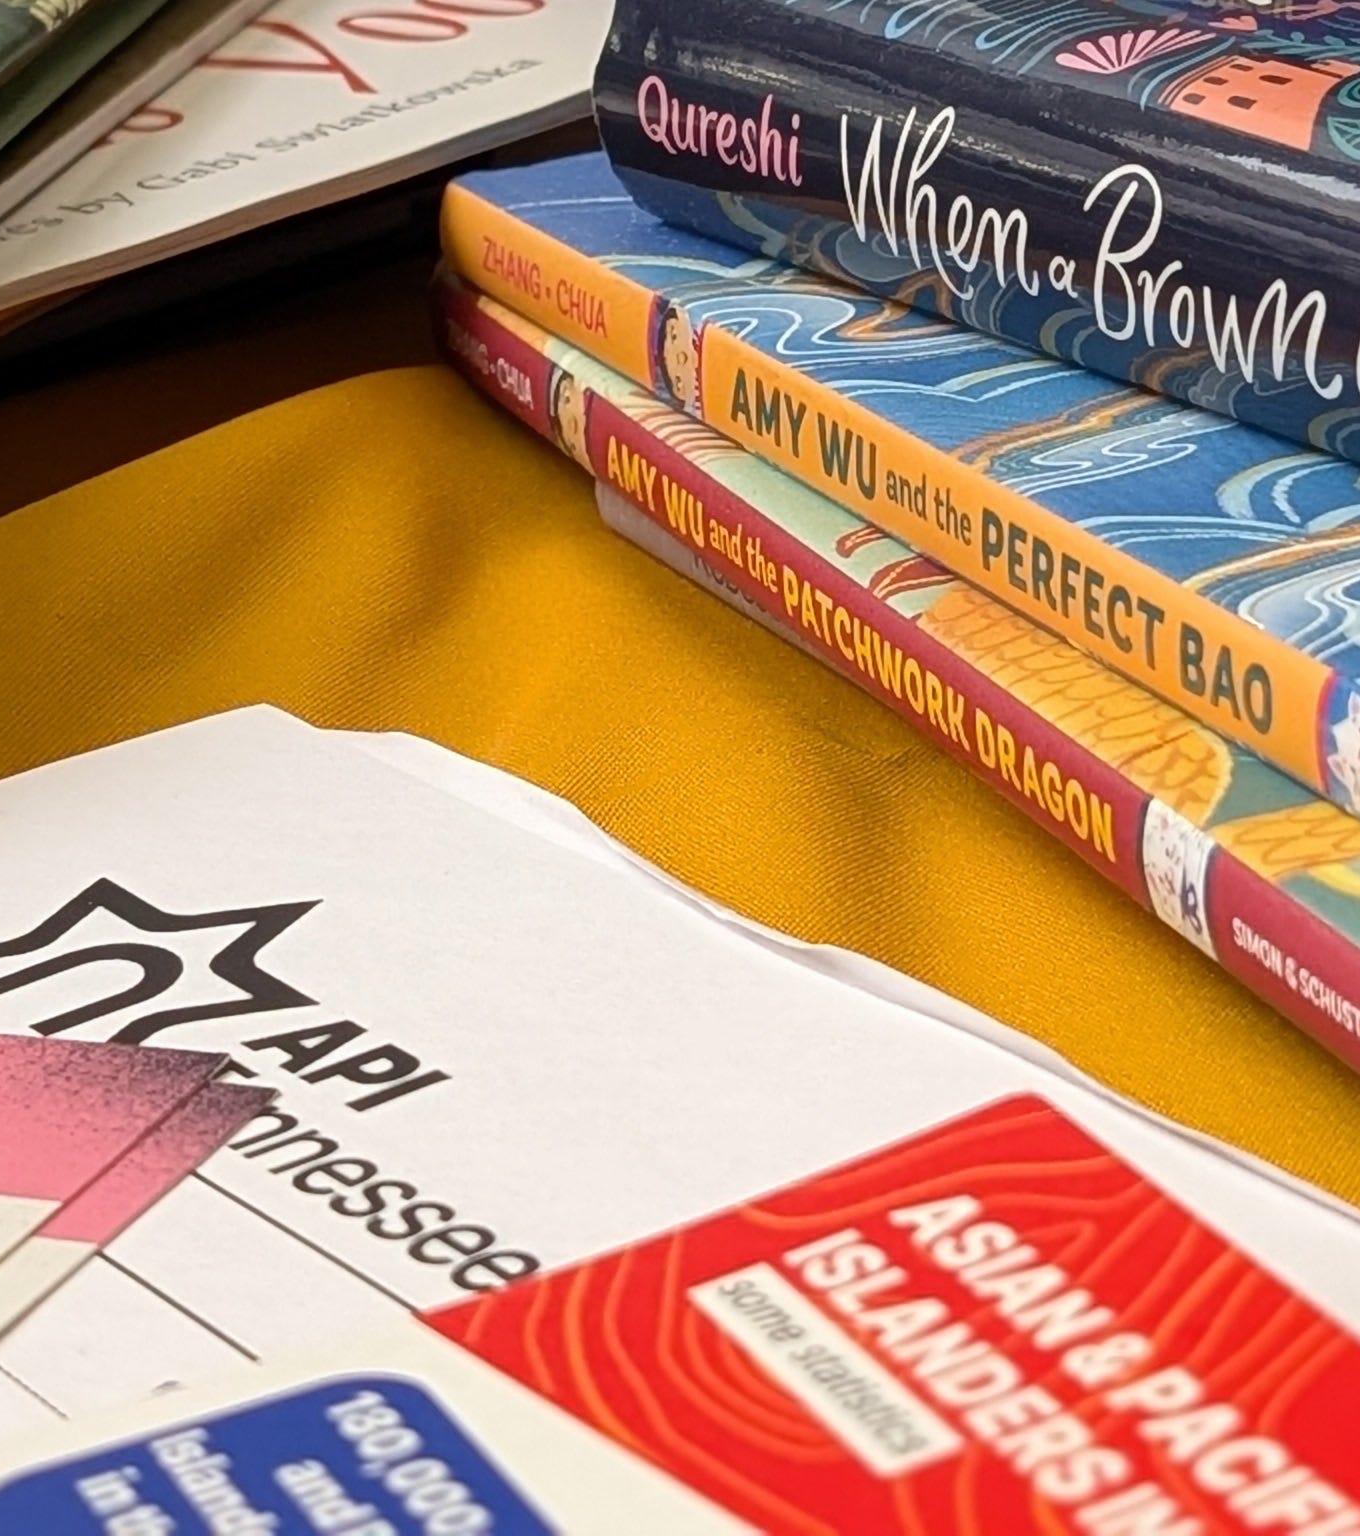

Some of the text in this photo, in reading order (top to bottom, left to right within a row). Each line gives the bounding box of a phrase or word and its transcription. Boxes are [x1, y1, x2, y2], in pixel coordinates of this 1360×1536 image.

[59, 190, 137, 219] by
[136, 151, 259, 193] Gabi
[637, 74, 803, 187] Qureshi
[482, 235, 609, 340] ZHANG CHUA
[840, 105, 1040, 301] When
[1049, 253, 1080, 300] a
[1083, 163, 1343, 400] Brown
[729, 366, 1274, 736] AMY WU and the PERFECT BAO
[606, 434, 658, 512] AMY
[662, 473, 706, 548] WU
[709, 518, 744, 570] and
[745, 536, 779, 594] the
[783, 564, 972, 752] PATCHWORK
[975, 707, 1117, 864] DRAGON
[1232, 916, 1284, 978] SIMON
[1285, 956, 1298, 993] &
[240, 1019, 454, 1113] API
[887, 1193, 1118, 1351] ASIAN
[1059, 1331, 1155, 1387] &
[718, 1279, 931, 1455] some statistics
[782, 1227, 1132, 1503] ISLANDERS
[272, 1458, 379, 1533] and
